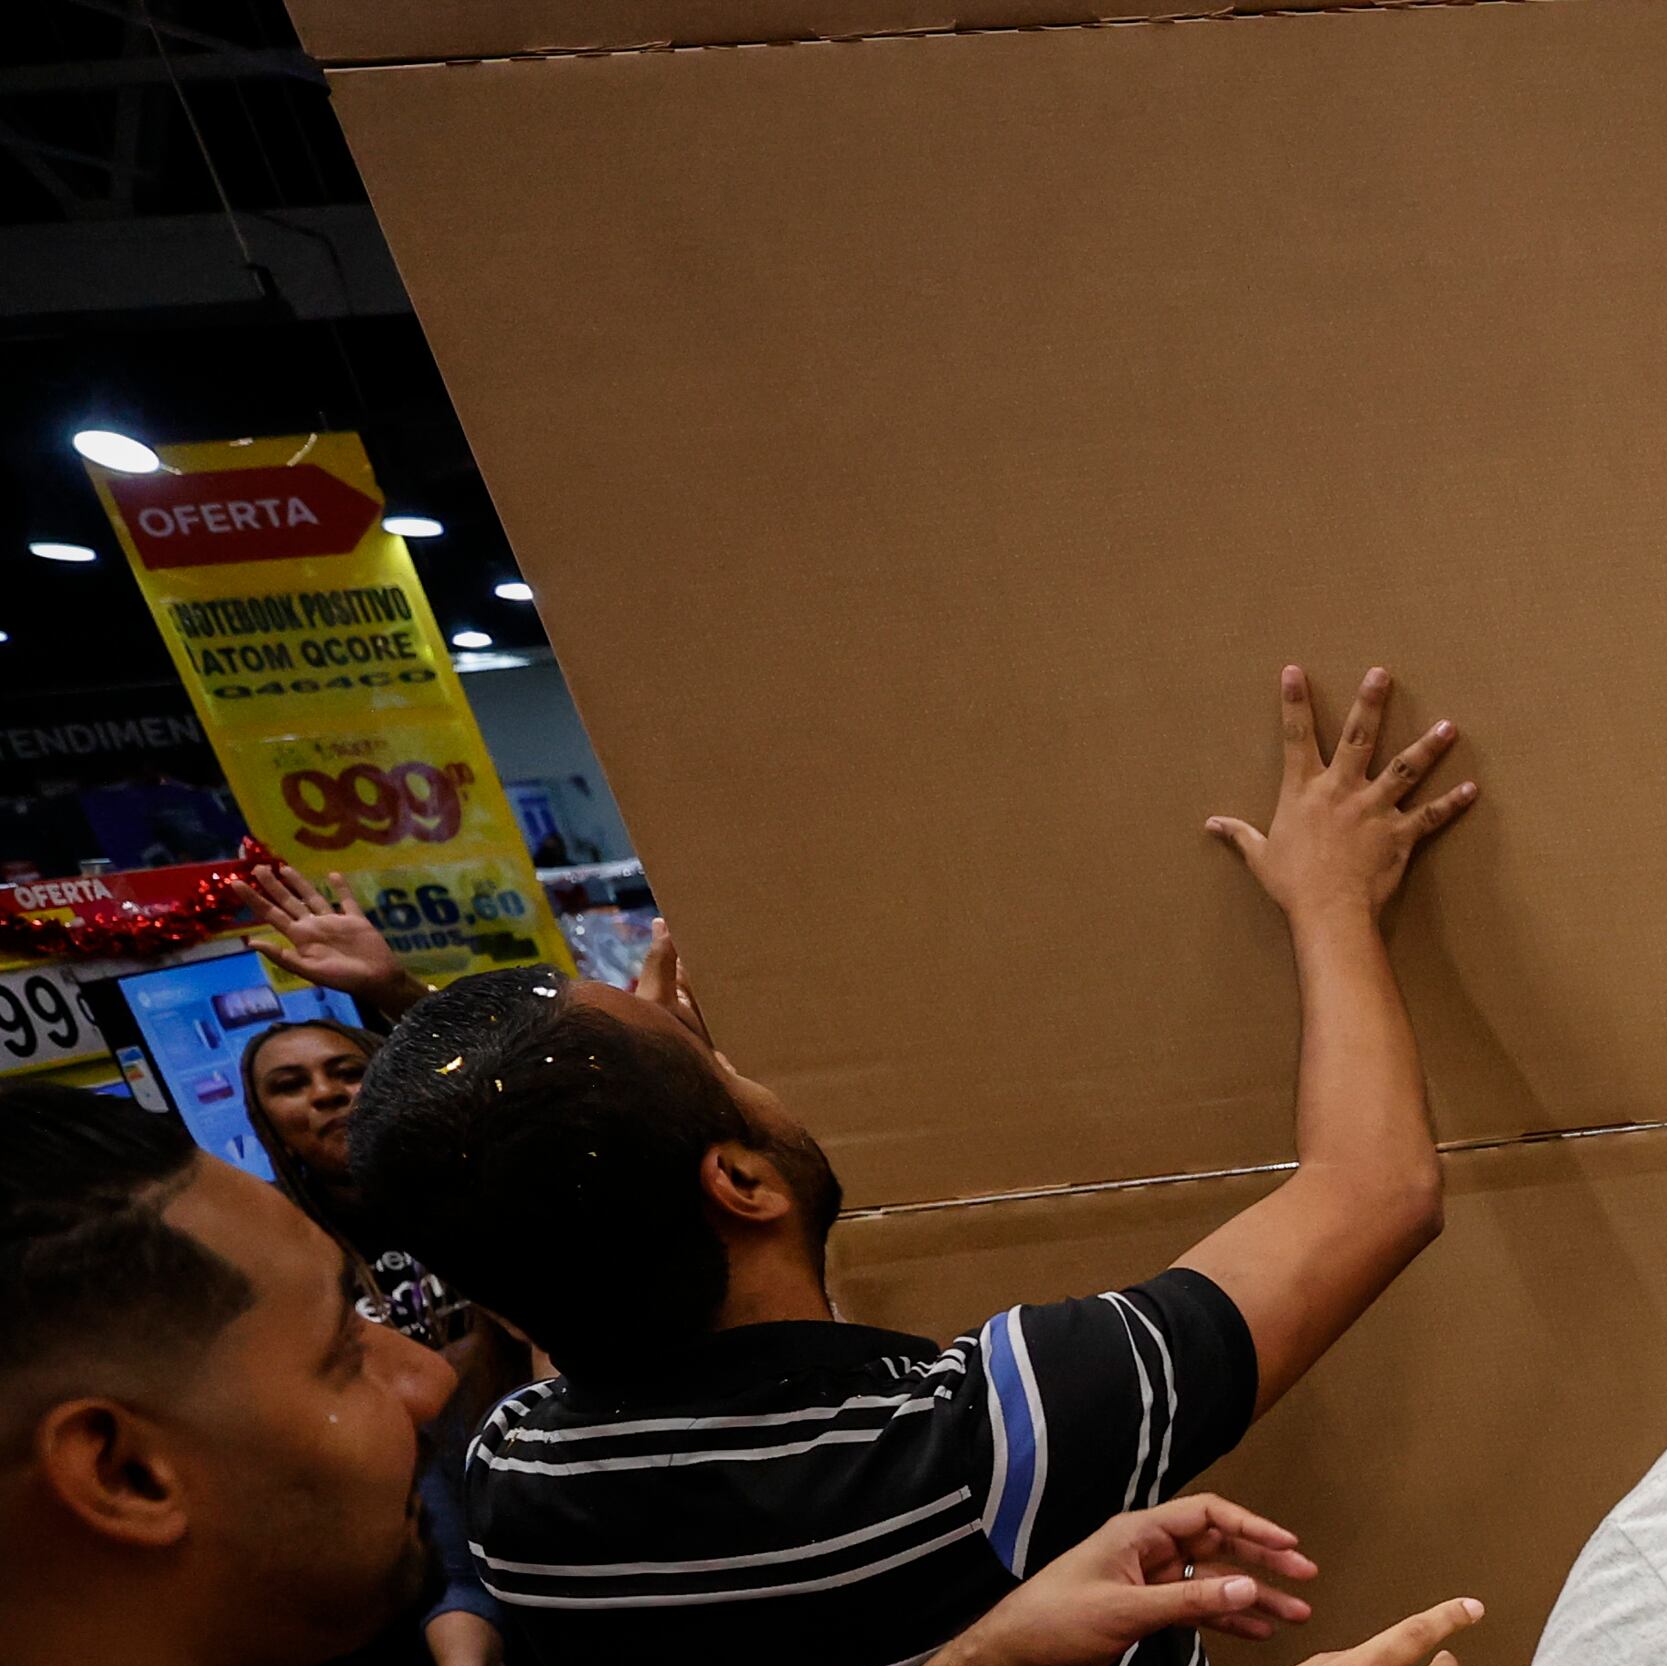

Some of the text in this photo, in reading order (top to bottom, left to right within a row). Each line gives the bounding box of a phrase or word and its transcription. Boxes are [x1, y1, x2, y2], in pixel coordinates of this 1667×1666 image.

[138, 496, 321, 538] OFERTA
[170, 585, 413, 640] NOTEBOOK POSITIVO
[201, 631, 418, 677] ATOM QCORE
[14, 879, 113, 910] OFERTA
